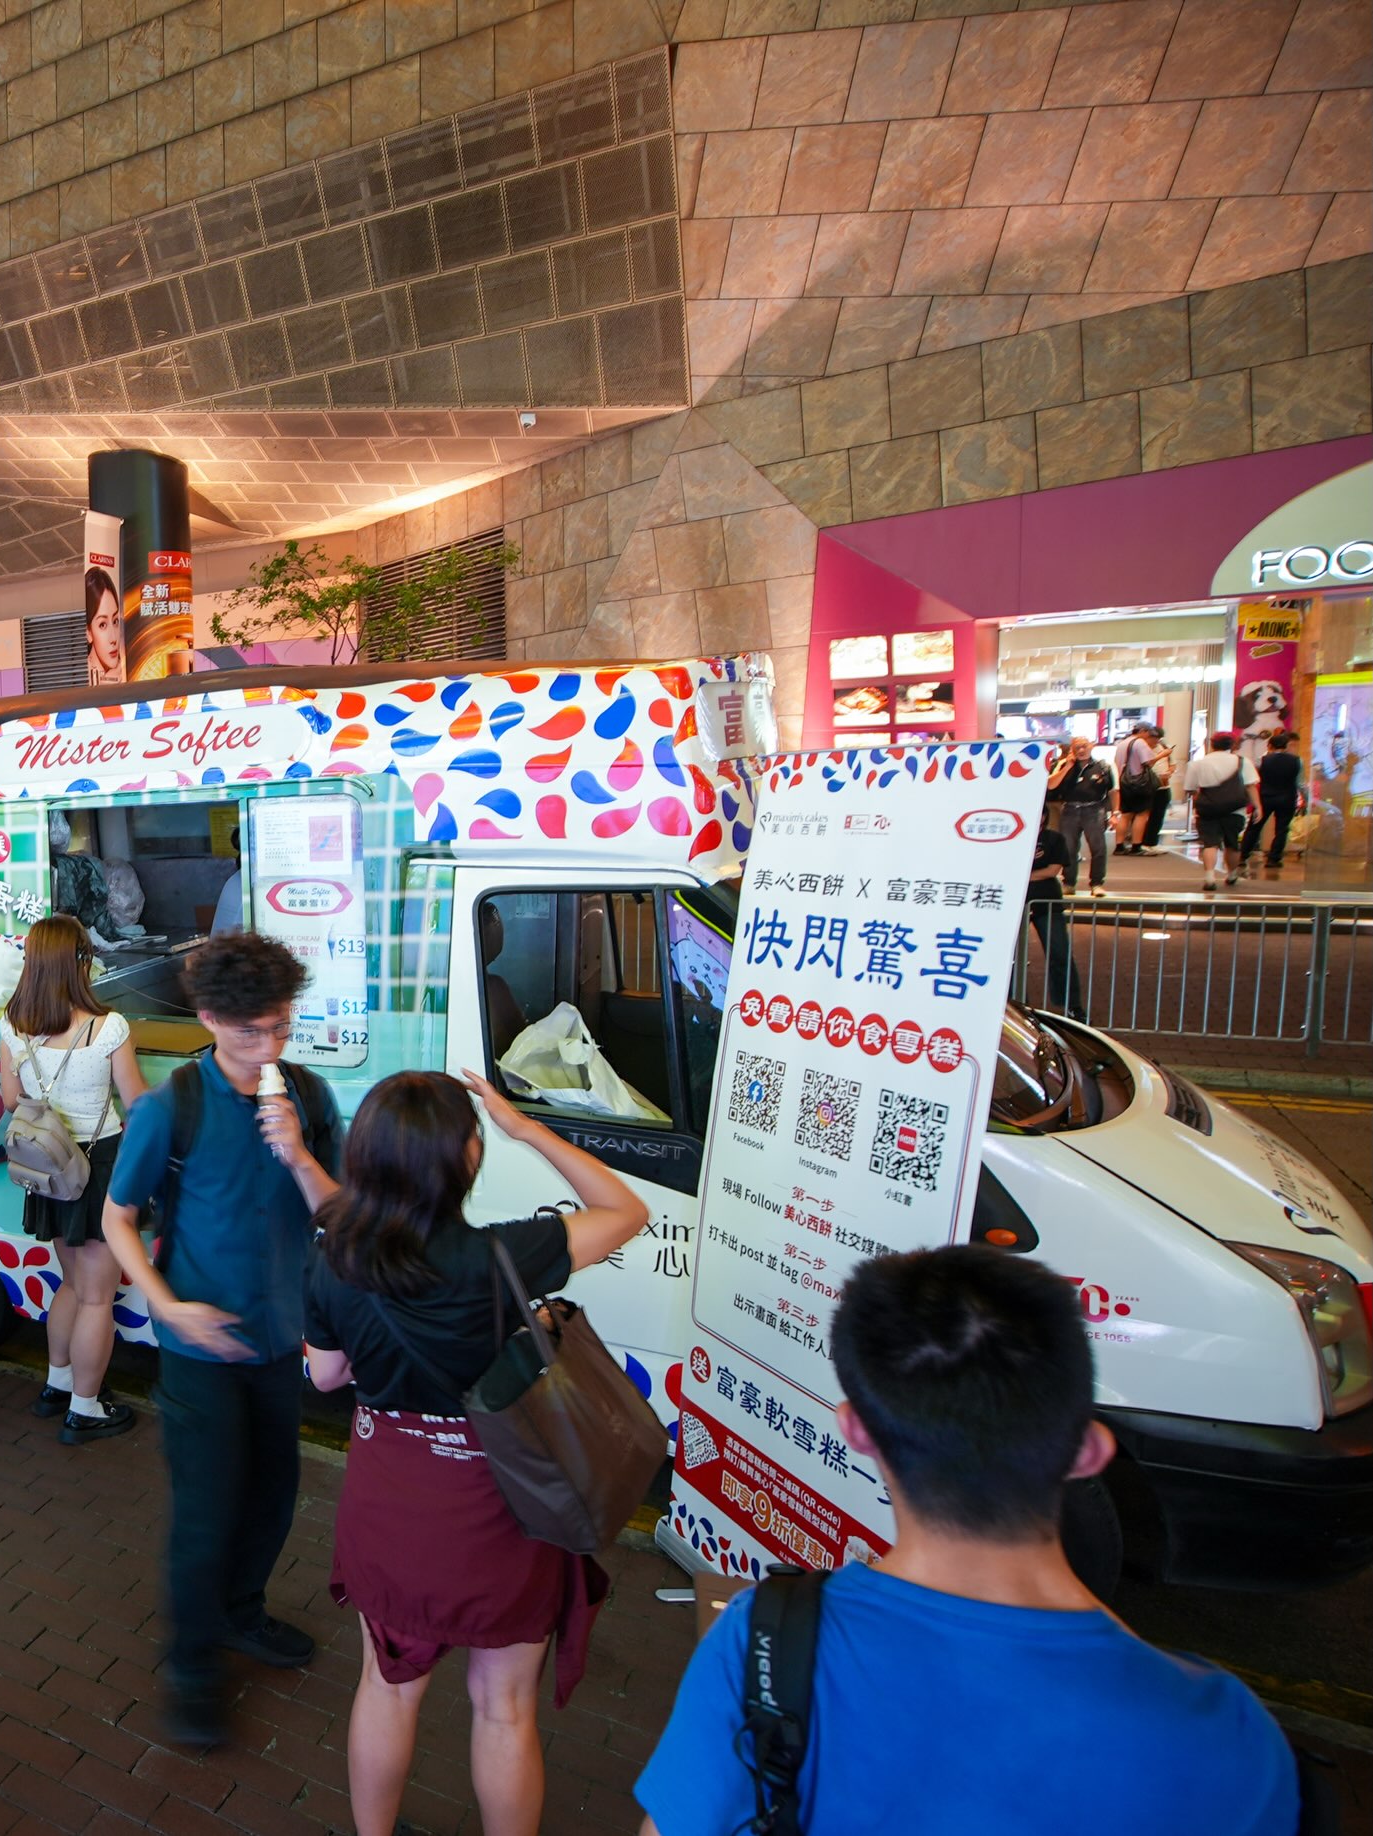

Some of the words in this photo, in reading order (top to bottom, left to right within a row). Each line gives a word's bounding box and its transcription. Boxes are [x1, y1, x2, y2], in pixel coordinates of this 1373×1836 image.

[142, 583, 170, 599] 全新
[139, 601, 193, 617] 賦活雙萃
[15, 733, 131, 770] Mister
[142, 716, 262, 766] Softee
[772, 823, 827, 837] 美心西餅
[805, 811, 829, 823] cakes
[311, 888, 331, 897] Softee
[753, 868, 845, 897] 美心西餅
[856, 877, 872, 899] X
[887, 877, 1005, 910] 富豪雪糕
[339, 938, 365, 955] $13
[743, 906, 990, 1000] 快閃驚喜
[342, 1000, 368, 1015] $12
[342, 1029, 368, 1045] $12
[741, 996, 962, 1067] 免費請你食雪糕
[569, 1132, 686, 1161] TRANSIT
[733, 1132, 765, 1151] Facebook
[798, 1156, 838, 1179] Instagram
[722, 1177, 743, 1200] 現場
[744, 1188, 783, 1216] Follow
[784, 1204, 833, 1238] 美心西餅
[792, 1185, 836, 1213] 第一步
[708, 1224, 738, 1252] 打卡出
[740, 1244, 764, 1263] post
[766, 1253, 778, 1272] 並
[780, 1261, 798, 1284] tag
[784, 1242, 827, 1271] 第二步
[777, 1297, 820, 1328] 第三步
[690, 1350, 710, 1382] 送
[817, 1505, 841, 1529] code)
